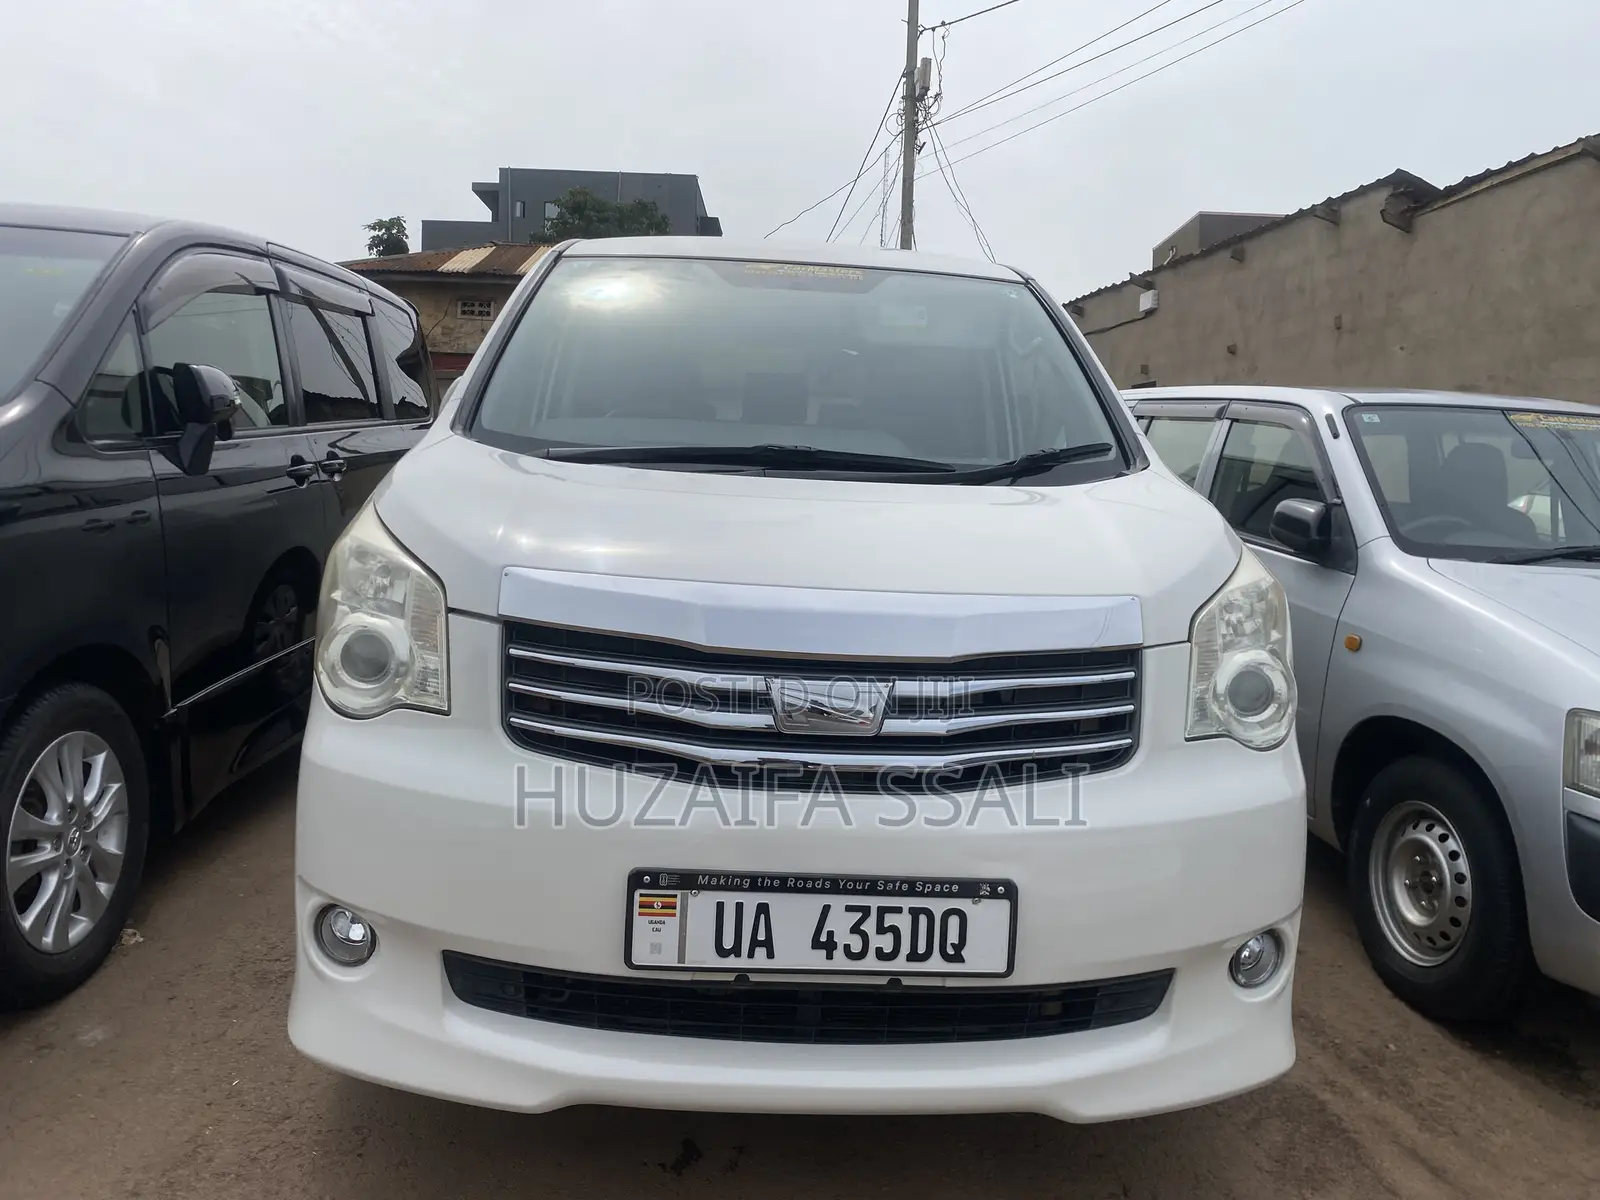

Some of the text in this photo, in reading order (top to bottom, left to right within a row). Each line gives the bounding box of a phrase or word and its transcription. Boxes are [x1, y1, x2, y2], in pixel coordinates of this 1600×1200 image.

[697, 874, 960, 894] Making the Roads Your Safe Space
[714, 900, 968, 963] UA 435DQ
